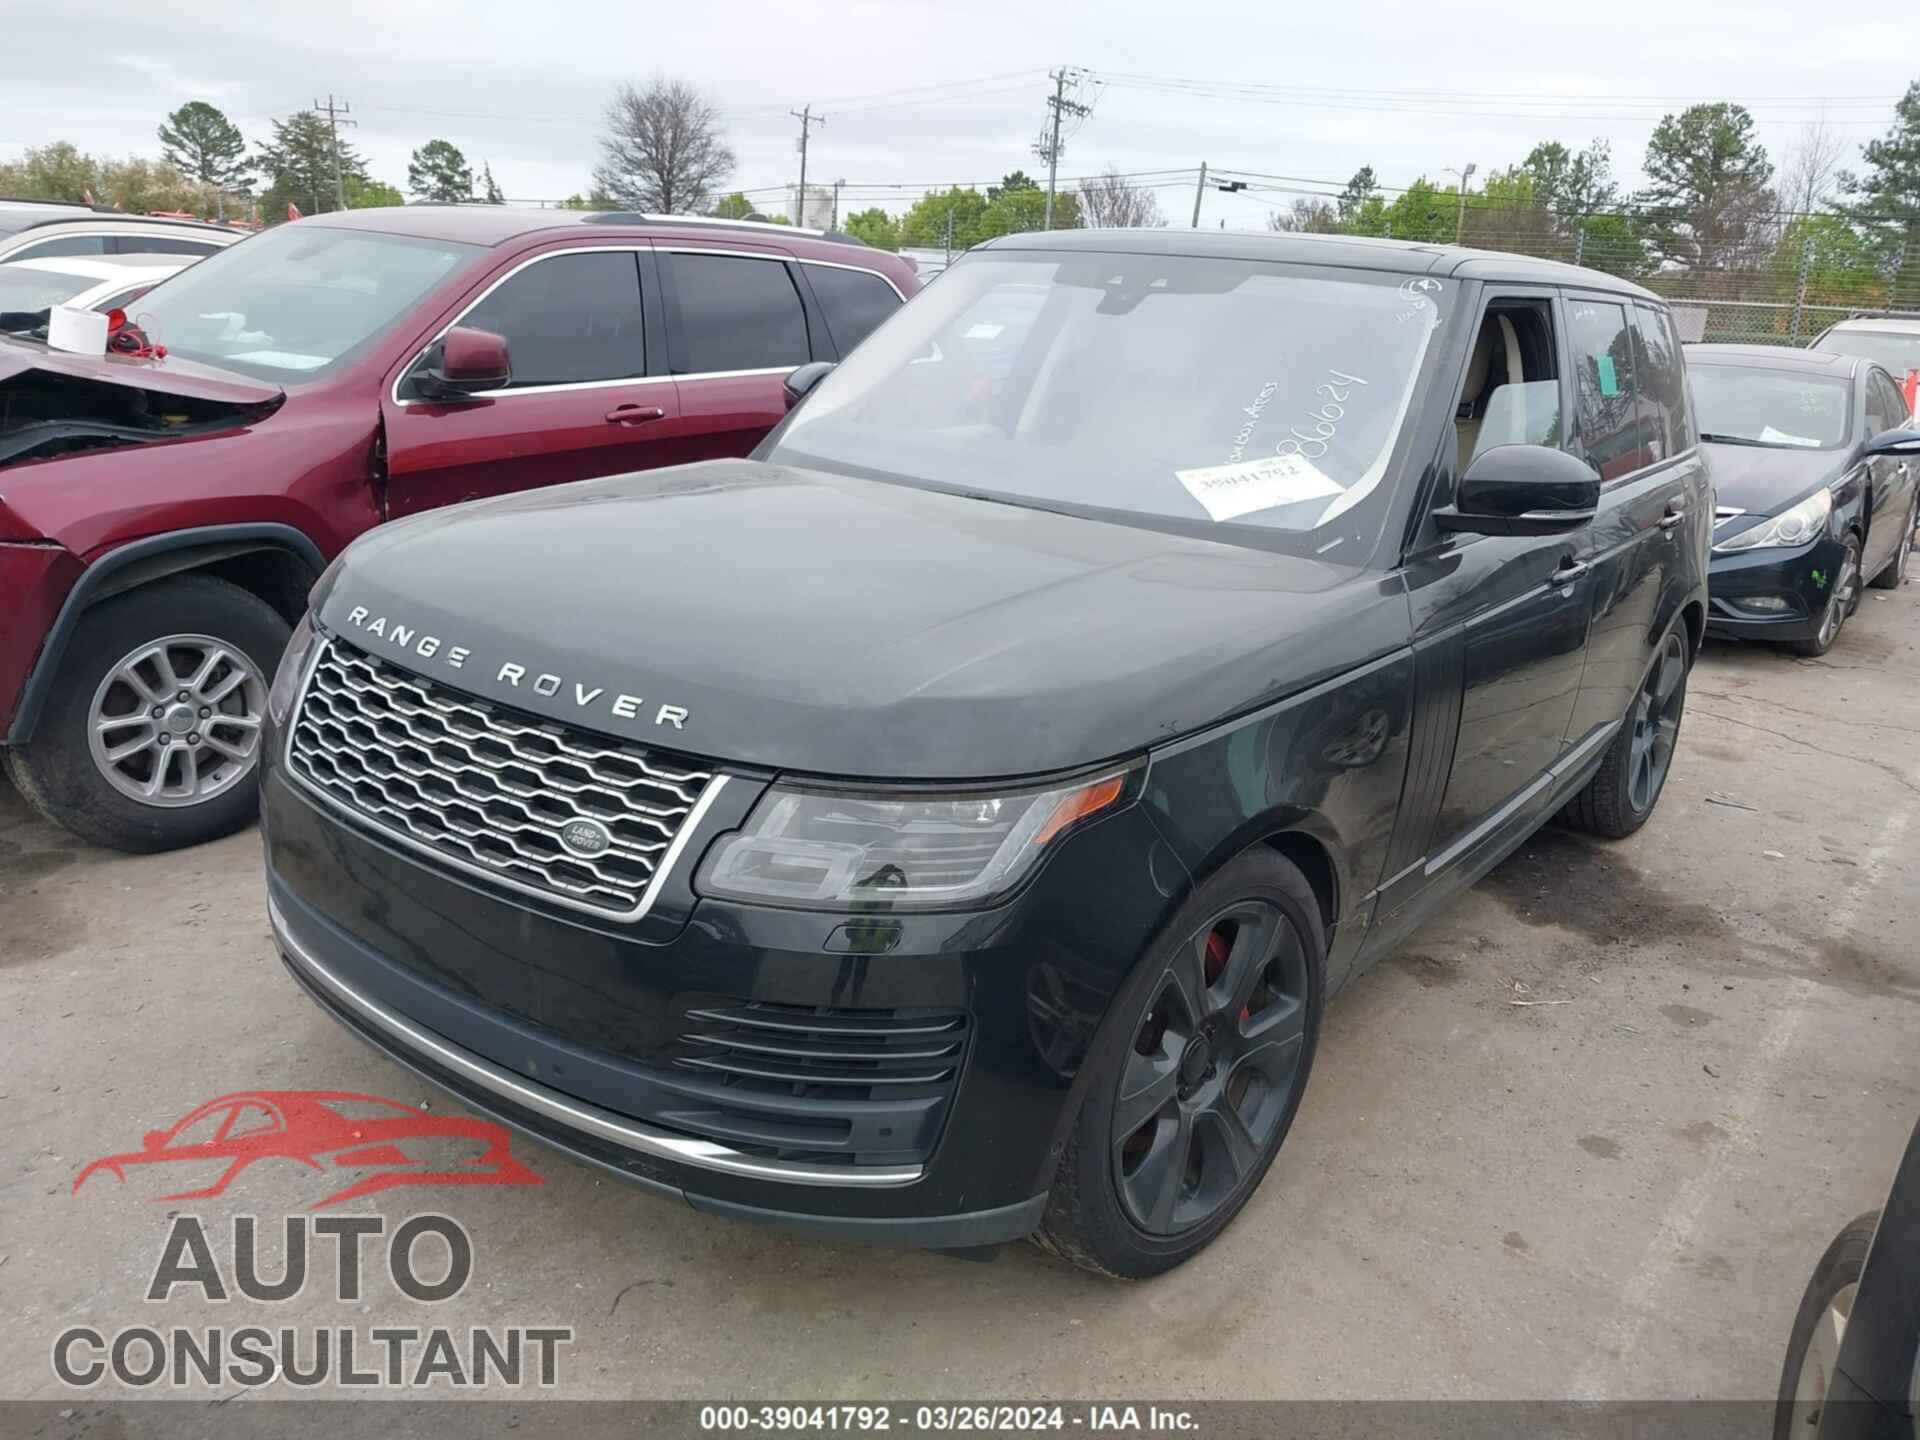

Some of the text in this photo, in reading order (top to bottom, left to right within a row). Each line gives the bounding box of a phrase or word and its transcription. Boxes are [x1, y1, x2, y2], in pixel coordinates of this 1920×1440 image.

[347, 605, 689, 730] RANGE ROVER
[572, 825, 596, 839] LAND
[571, 835, 601, 850] ROVER
